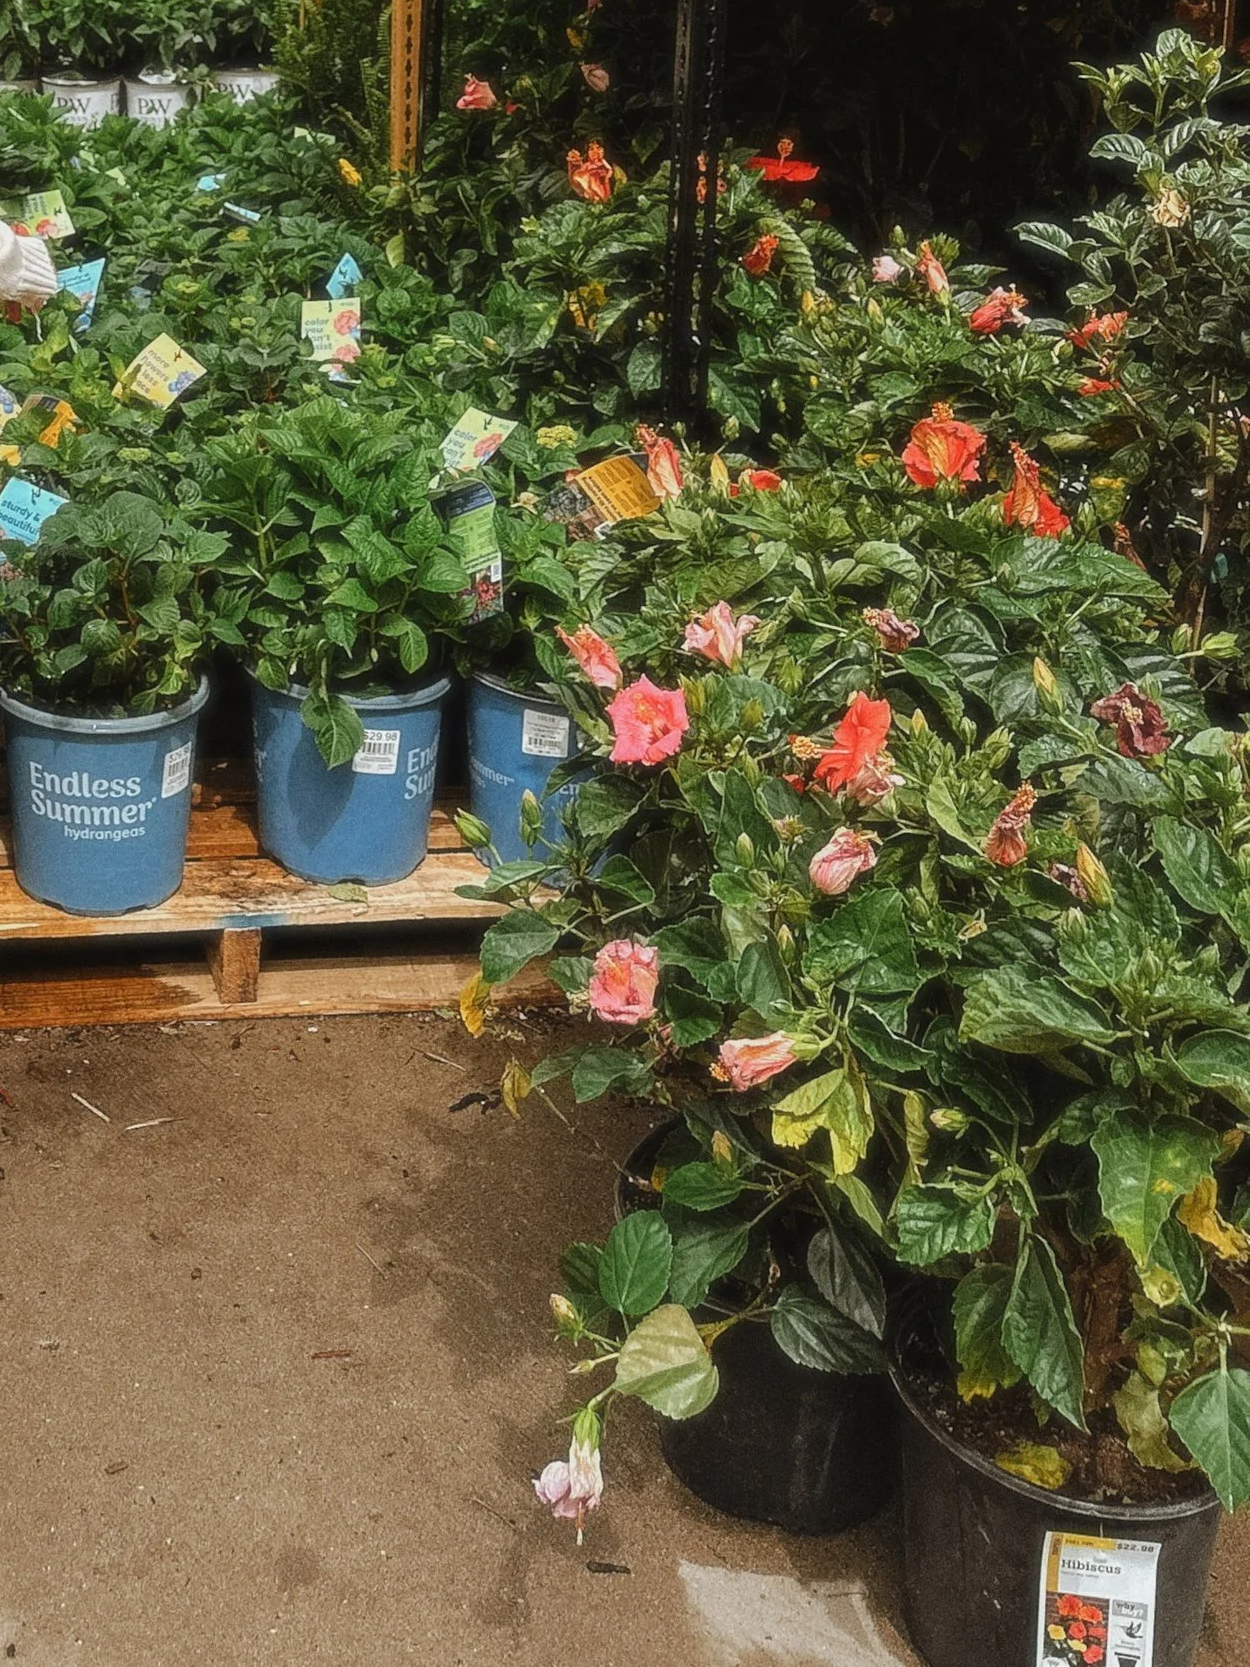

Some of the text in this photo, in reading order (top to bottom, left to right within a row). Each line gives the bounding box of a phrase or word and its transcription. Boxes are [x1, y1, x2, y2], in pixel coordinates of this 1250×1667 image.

[137, 97, 172, 115] PW
[312, 334, 330, 342] an't
[148, 349, 170, 369] more
[1, 499, 41, 523] sturdy &
[29, 761, 142, 799] Endless
[30, 789, 153, 826] Summer
[64, 825, 146, 842] hydrangeas
[1116, 1542, 1155, 1554] $22.98
[1061, 1558, 1122, 1576] Hibiscus
[1116, 1600, 1136, 1612] why
